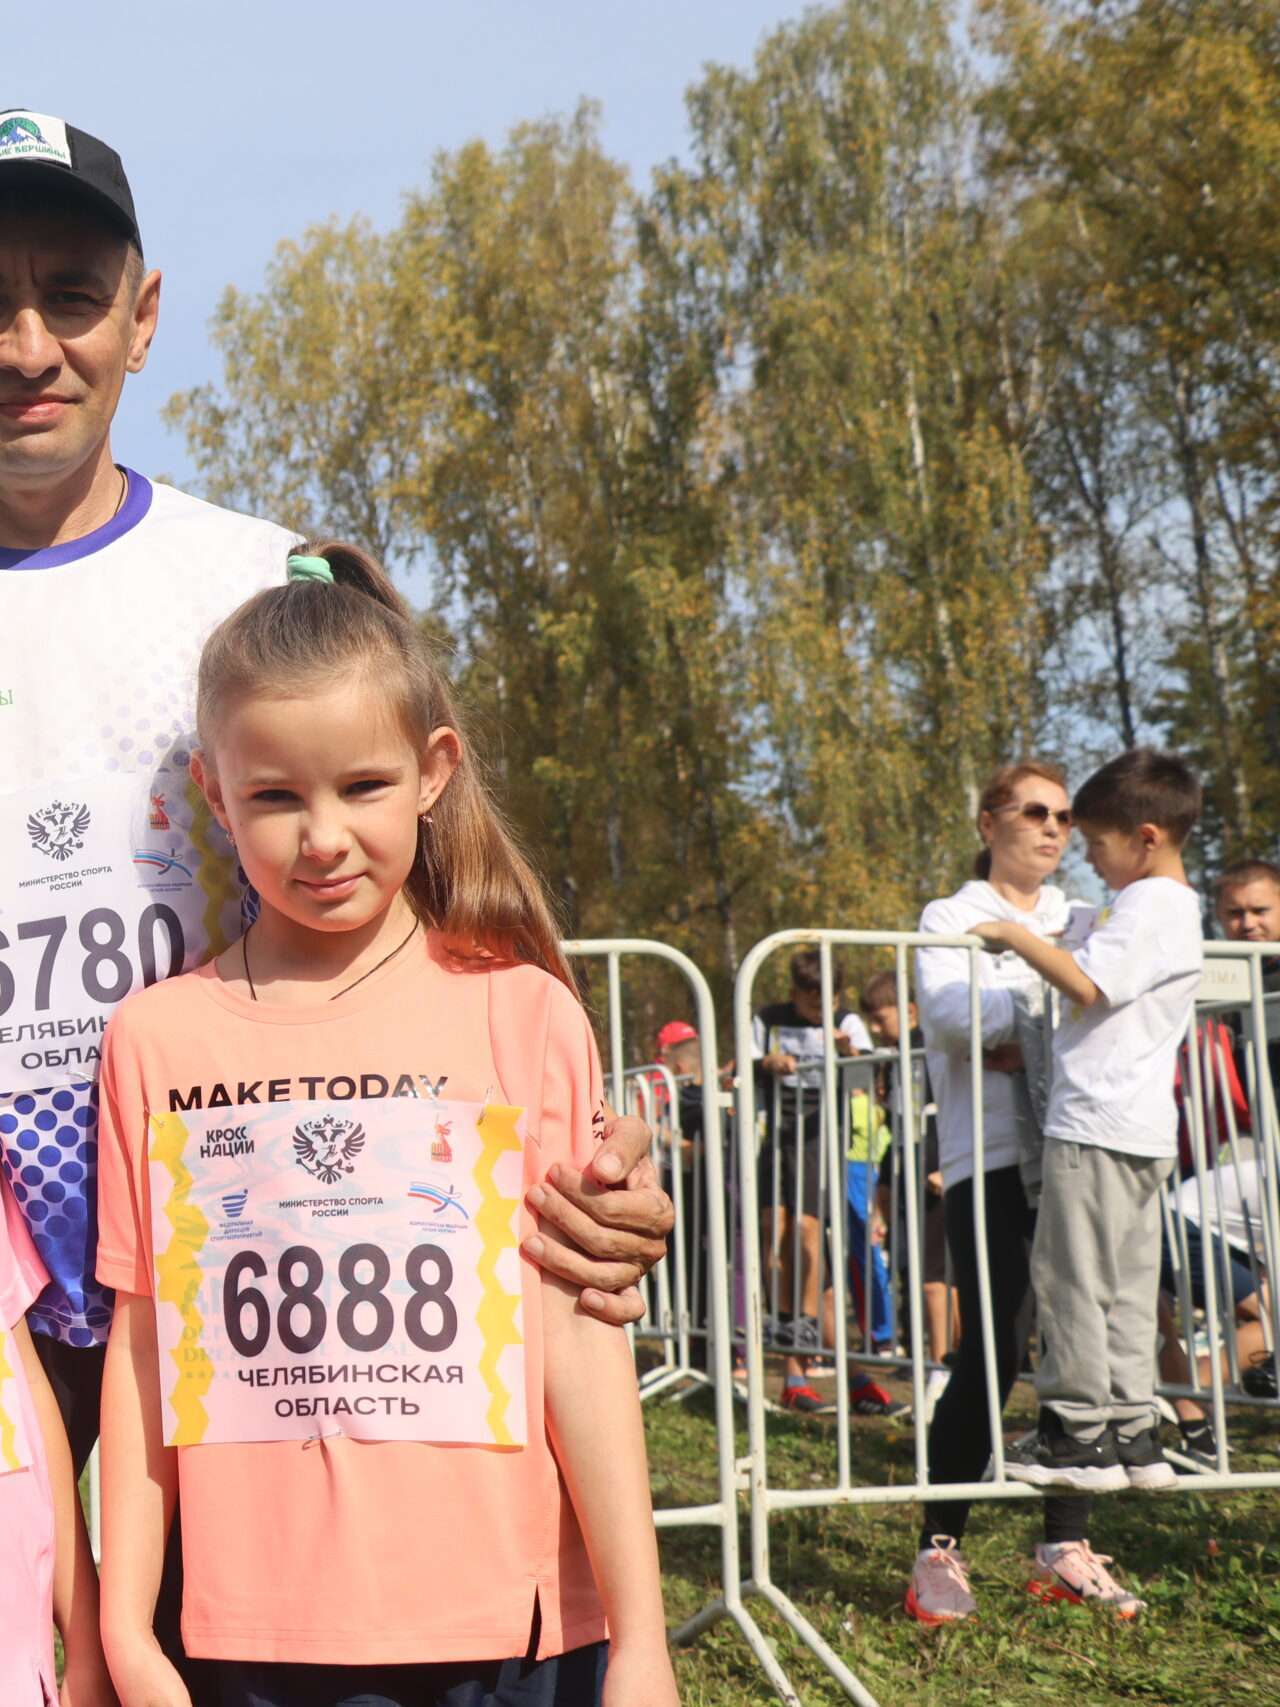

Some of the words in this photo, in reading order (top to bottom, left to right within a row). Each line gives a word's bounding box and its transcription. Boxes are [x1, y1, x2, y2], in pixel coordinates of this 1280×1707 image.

[18, 871, 79, 889] МИНИСТЕРСТВО
[80, 865, 113, 877] СПОРТА
[49, 880, 83, 892] РОССИИ
[20, 1045, 102, 1070] ОБЛА
[168, 1078, 291, 1112] MAKE
[298, 1073, 449, 1101] TODAY
[206, 1125, 248, 1144] КРОСС
[200, 1139, 255, 1159] НАЦИИ
[278, 1198, 347, 1209] МИНИСТЕРСТВО
[348, 1197, 384, 1206] СПОРТА
[312, 1208, 349, 1218] РОССИИ
[223, 1242, 458, 1358] 6888
[237, 1363, 464, 1388] ЧЕЛЯБИНСКАЯ
[274, 1396, 421, 1418] ОБЛАСТЬ
